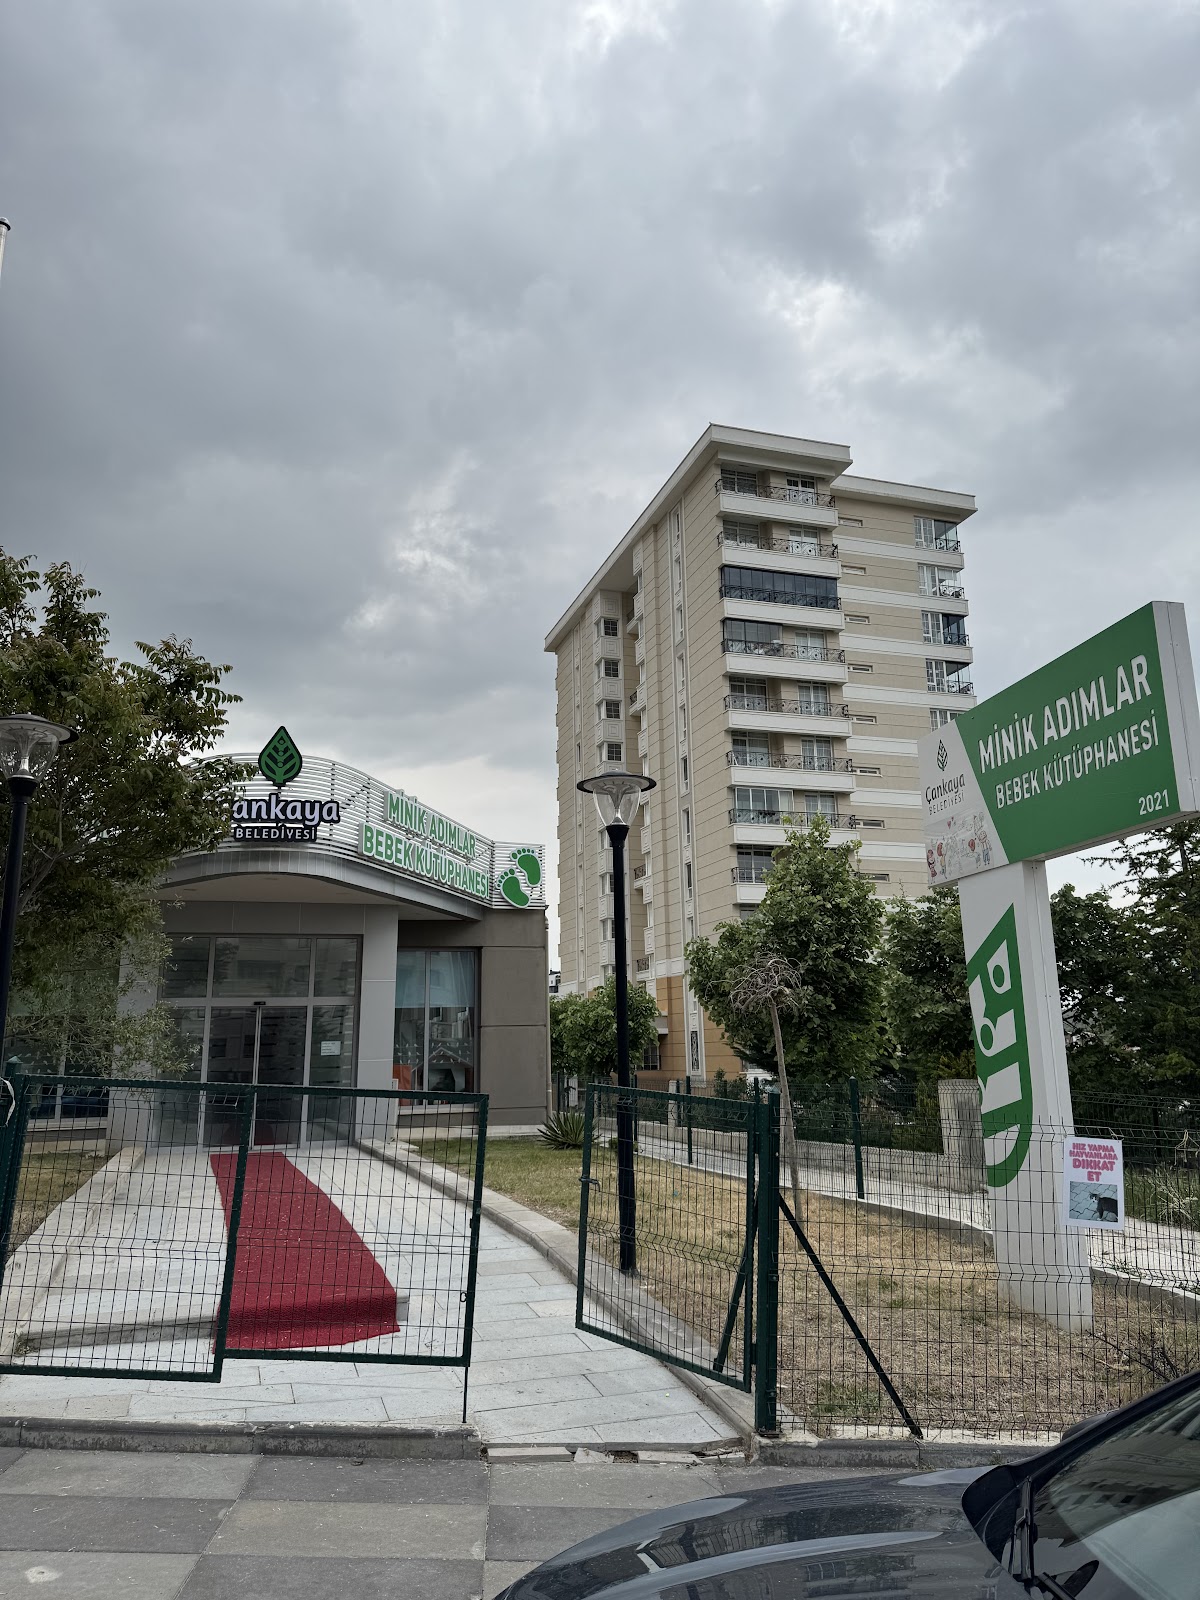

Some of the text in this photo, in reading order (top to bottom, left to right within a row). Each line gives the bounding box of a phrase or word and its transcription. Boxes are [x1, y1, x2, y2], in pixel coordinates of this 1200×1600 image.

[978, 654, 1152, 774] MİNİK ADIMLAR
[995, 709, 1159, 809] BEBEK KÜTÜPHANESİ
[925, 773, 966, 804] Çankaya
[928, 789, 965, 815] BELEDİYESİ
[1138, 788, 1170, 816] 2021
[233, 794, 339, 826] ankaya
[387, 791, 477, 858] MİNİK ADIMLAR
[235, 826, 316, 840] BELEDİYESİ
[362, 822, 490, 899] BEBEK KÜTÜPHANESİ
[1069, 1150, 1118, 1160] HAYVANLARA
[1072, 1142, 1115, 1153] HIZ YAPMA
[1087, 1171, 1102, 1182] ET
